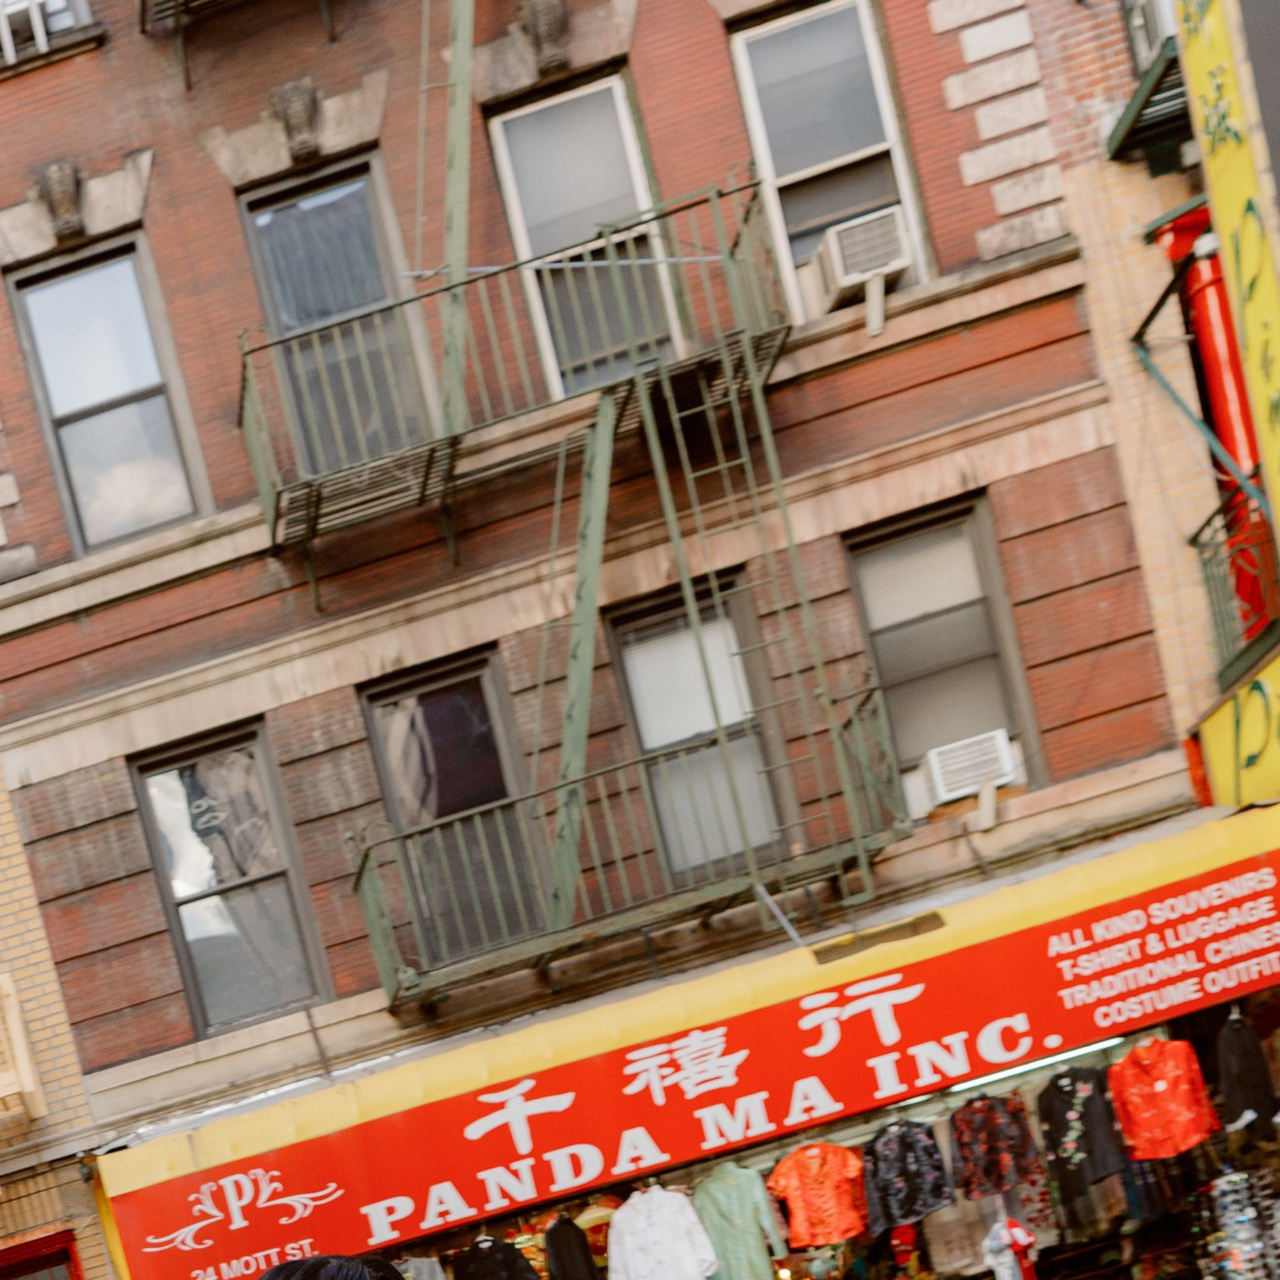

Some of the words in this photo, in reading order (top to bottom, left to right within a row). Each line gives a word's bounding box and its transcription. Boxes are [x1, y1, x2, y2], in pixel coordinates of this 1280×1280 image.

[1047, 928, 1093, 958] ALL
[1091, 908, 1148, 943] KIND
[1147, 866, 1277, 925] SOUVENIRS
[1056, 937, 1142, 981] T-SHIRT
[1144, 932, 1165, 955] &
[1165, 894, 1277, 949] LUGGAGE
[1057, 950, 1205, 1010] TRADITIONAL
[1093, 976, 1203, 1028] COSTUME
[463, 973, 925, 1155] 千禧行
[359, 1127, 671, 1246] PANDA
[693, 1075, 844, 1151] MA
[866, 1012, 1064, 1101] INC.
[219, 1247, 281, 1280] MOTT
[284, 1238, 320, 1262] ST.
